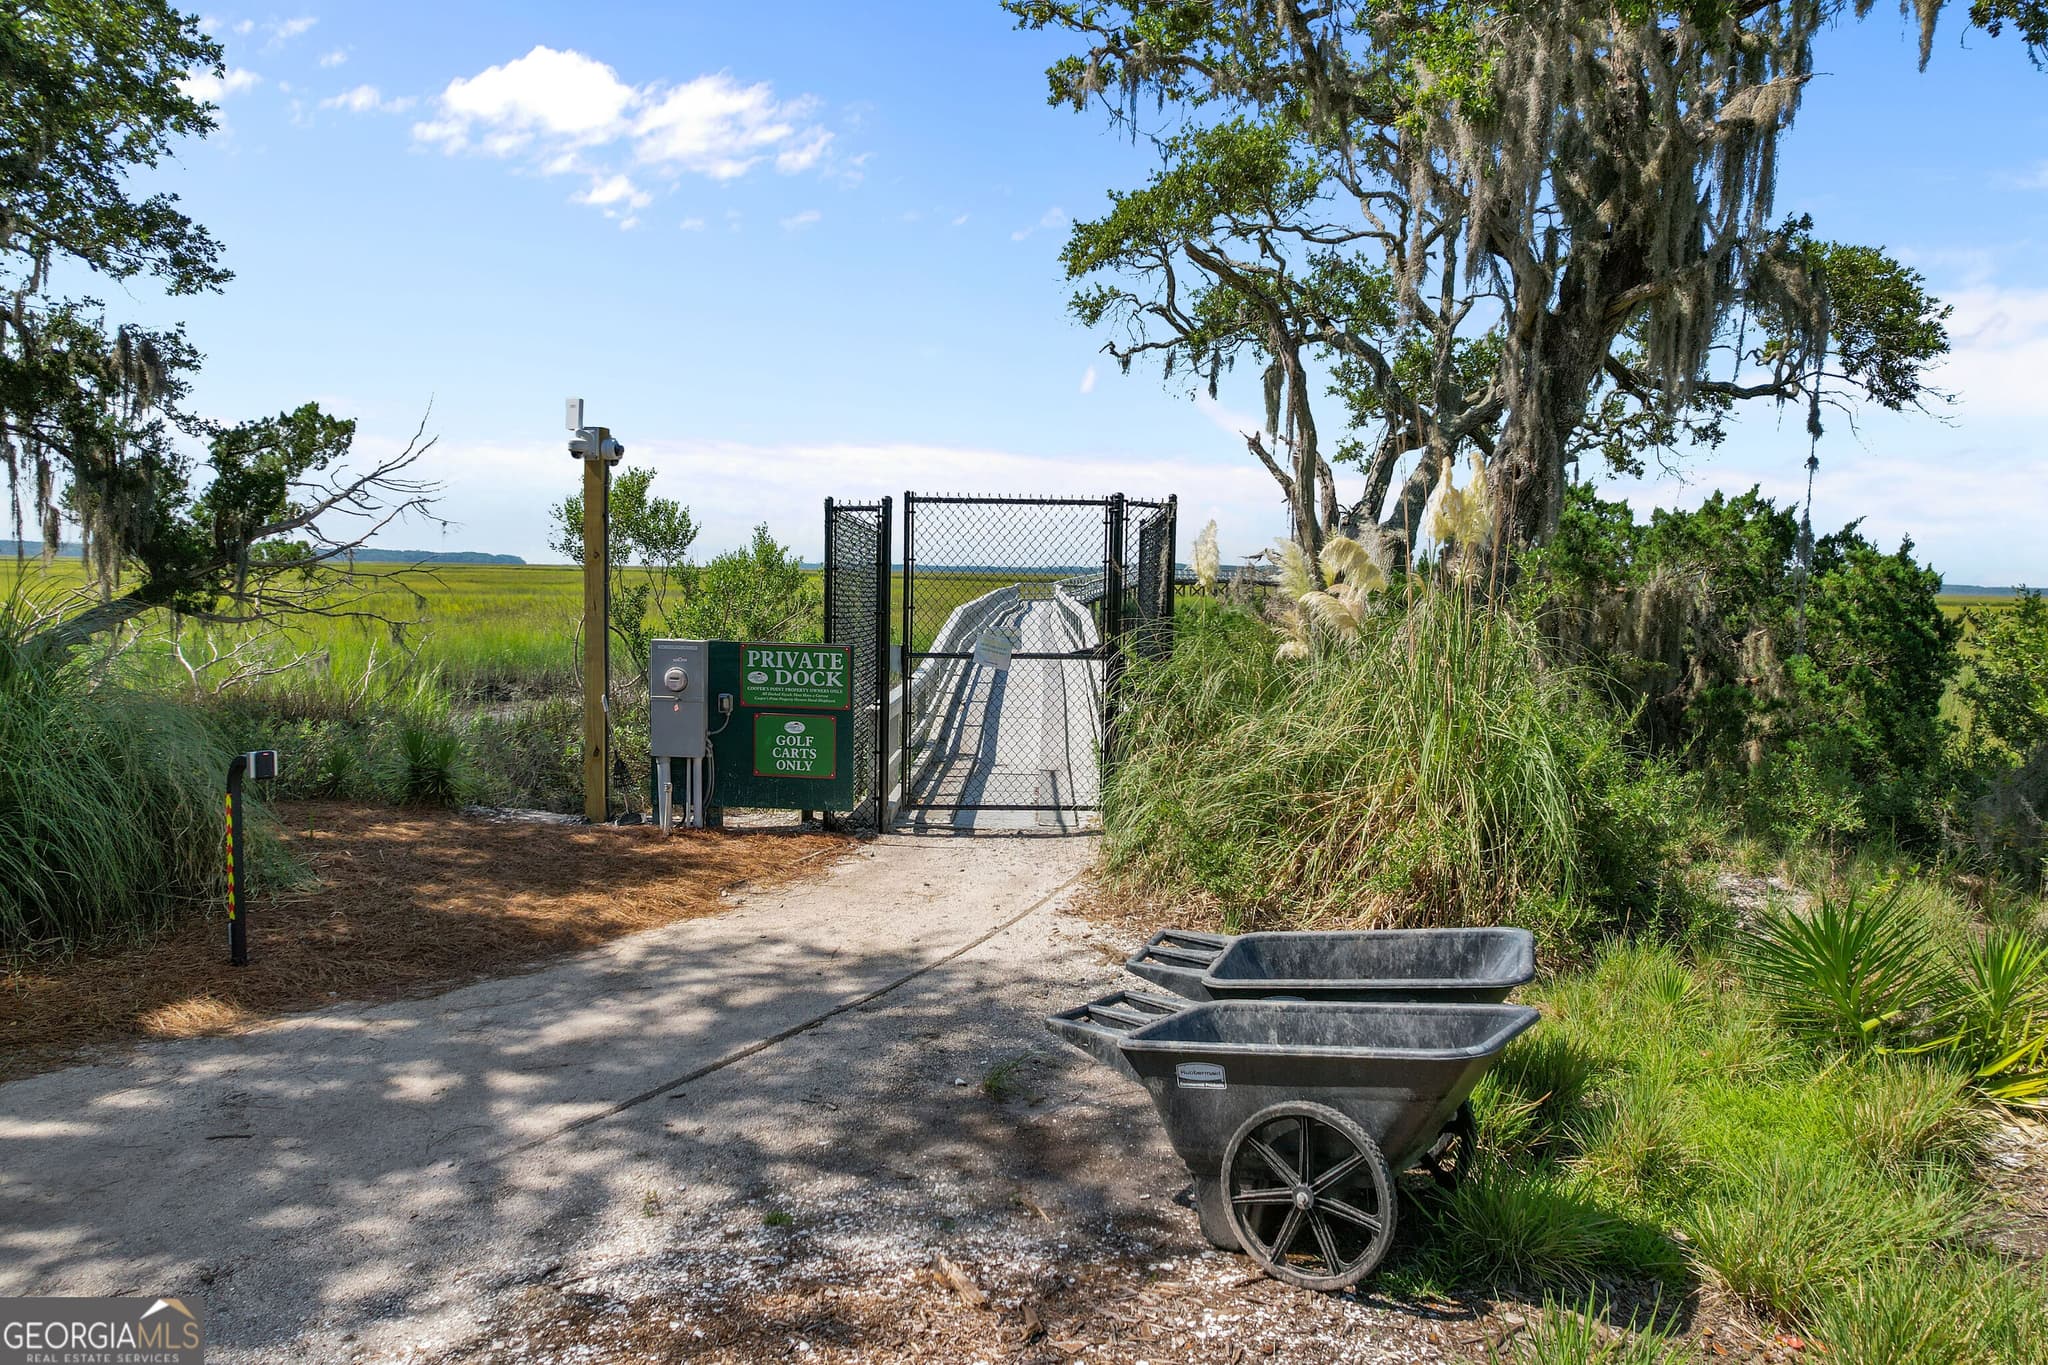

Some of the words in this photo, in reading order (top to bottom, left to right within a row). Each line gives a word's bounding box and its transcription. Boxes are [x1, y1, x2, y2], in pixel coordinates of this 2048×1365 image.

[747, 650, 844, 670] PRIVATE
[774, 669, 844, 687] DOCK
[776, 735, 814, 747] GOLF
[772, 747, 817, 759] CARTS
[776, 759, 813, 771] ONLY
